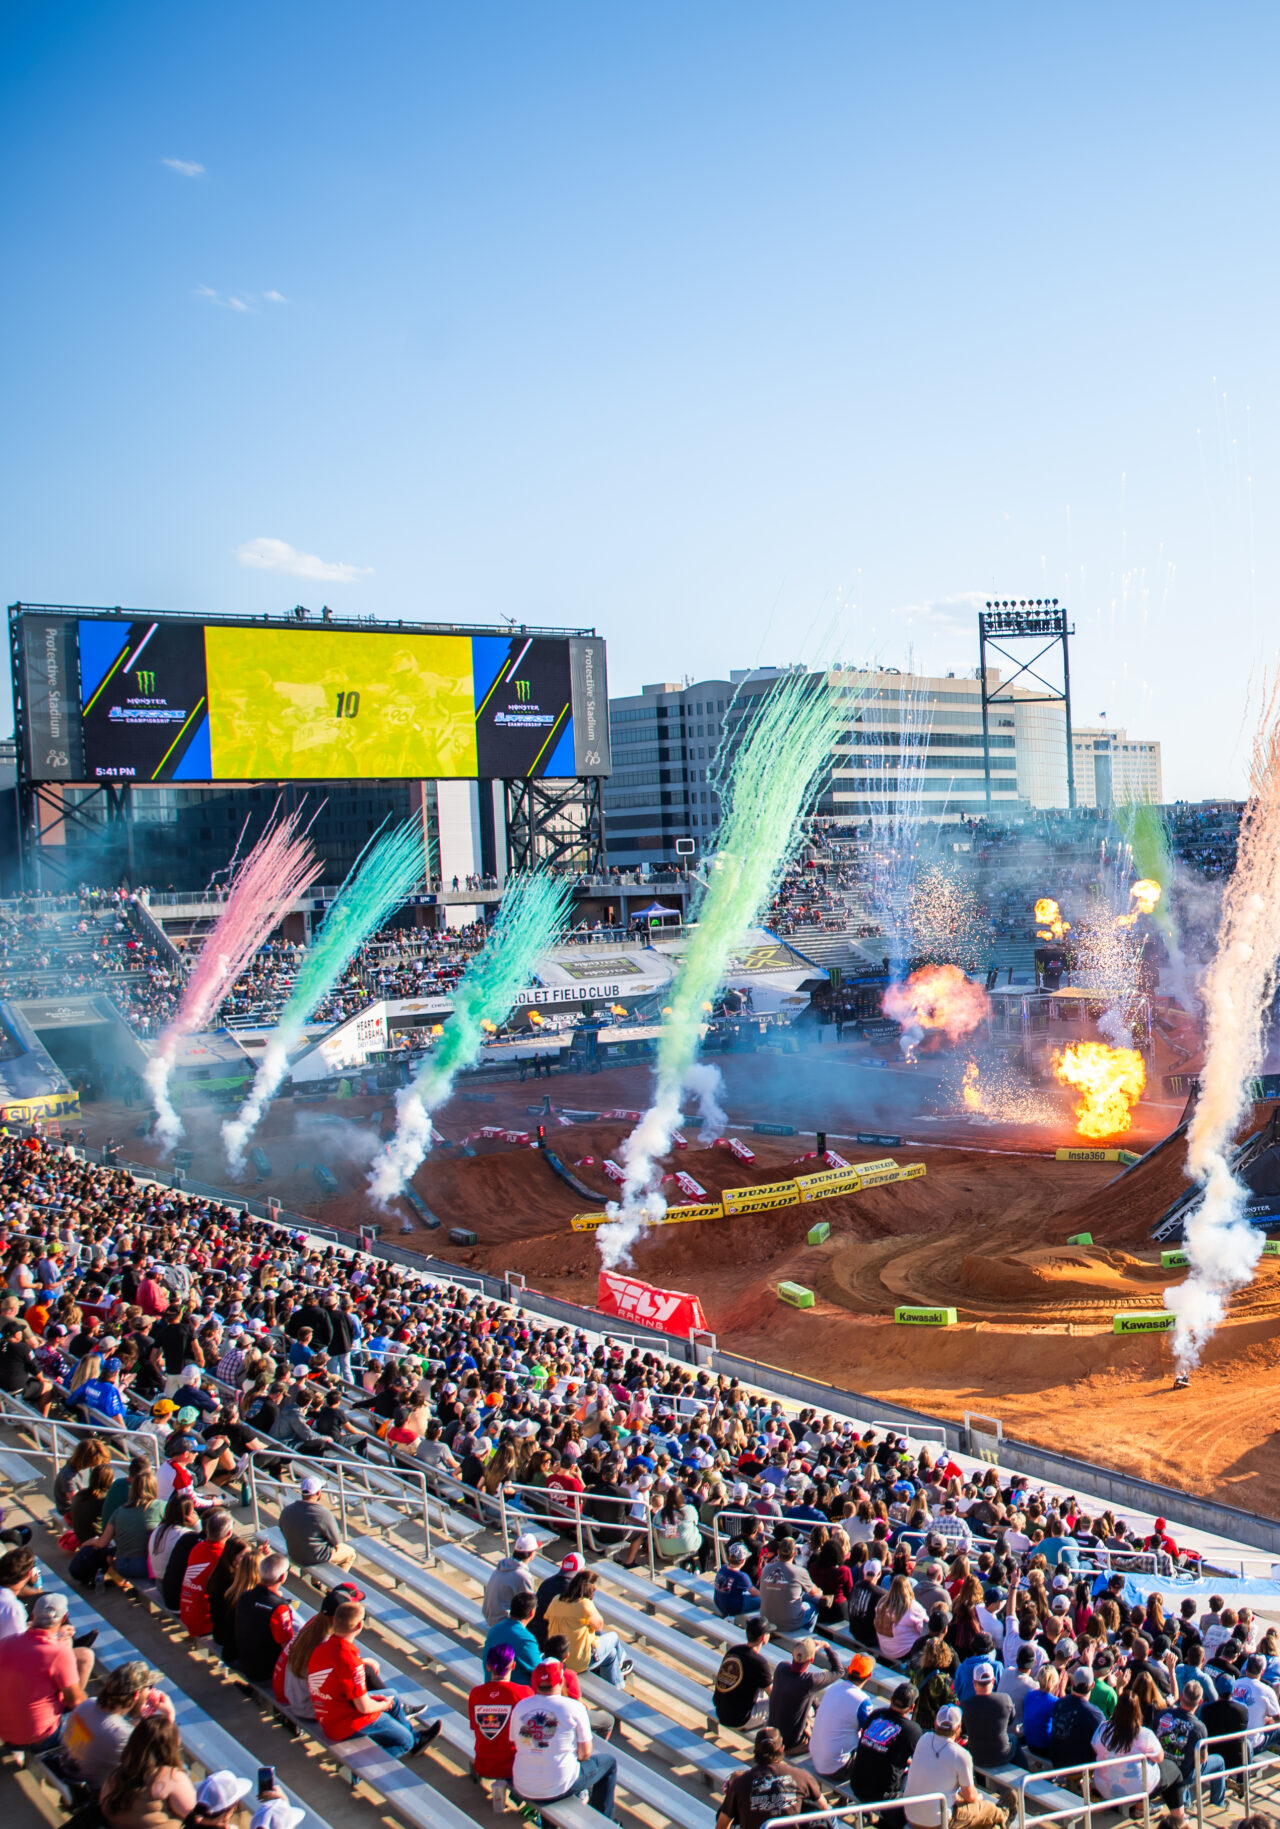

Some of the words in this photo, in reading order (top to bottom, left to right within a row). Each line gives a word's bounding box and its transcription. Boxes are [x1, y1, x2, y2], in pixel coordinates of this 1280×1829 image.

[45, 627, 60, 686] Protective
[584, 648, 595, 697] Protective
[126, 698, 168, 706] MONSTER
[335, 690, 361, 719] 10
[508, 704, 540, 712] MONSTER
[48, 690, 62, 738] Stadium
[586, 701, 597, 741] Stadium
[95, 767, 117, 776] 5:41
[119, 767, 136, 776] PM
[513, 990, 549, 1004] OLET
[553, 987, 586, 1001] FIELD
[589, 985, 620, 998] CLUB
[356, 1018, 375, 1032] HEART
[357, 1029, 385, 1042] ALABAMA
[482, 1130, 494, 1139] FLY
[506, 1134, 518, 1143] FLY
[1068, 1151, 1105, 1161] Insta360
[863, 1160, 896, 1173] DUNLOP
[810, 1169, 854, 1185] DUNLOP
[868, 1172, 900, 1185] DUNLOP
[677, 1178, 693, 1196] FLY
[737, 1183, 796, 1199] DUNLOP
[815, 1181, 859, 1199] DUNLOP
[740, 1196, 797, 1213] DUNLOP
[660, 1207, 720, 1222] DUNLOP
[606, 1277, 682, 1322] FLY
[617, 1308, 664, 1331] RACING
[898, 1311, 943, 1325] Kawasaki
[1121, 1318, 1176, 1331] Kawasaki
